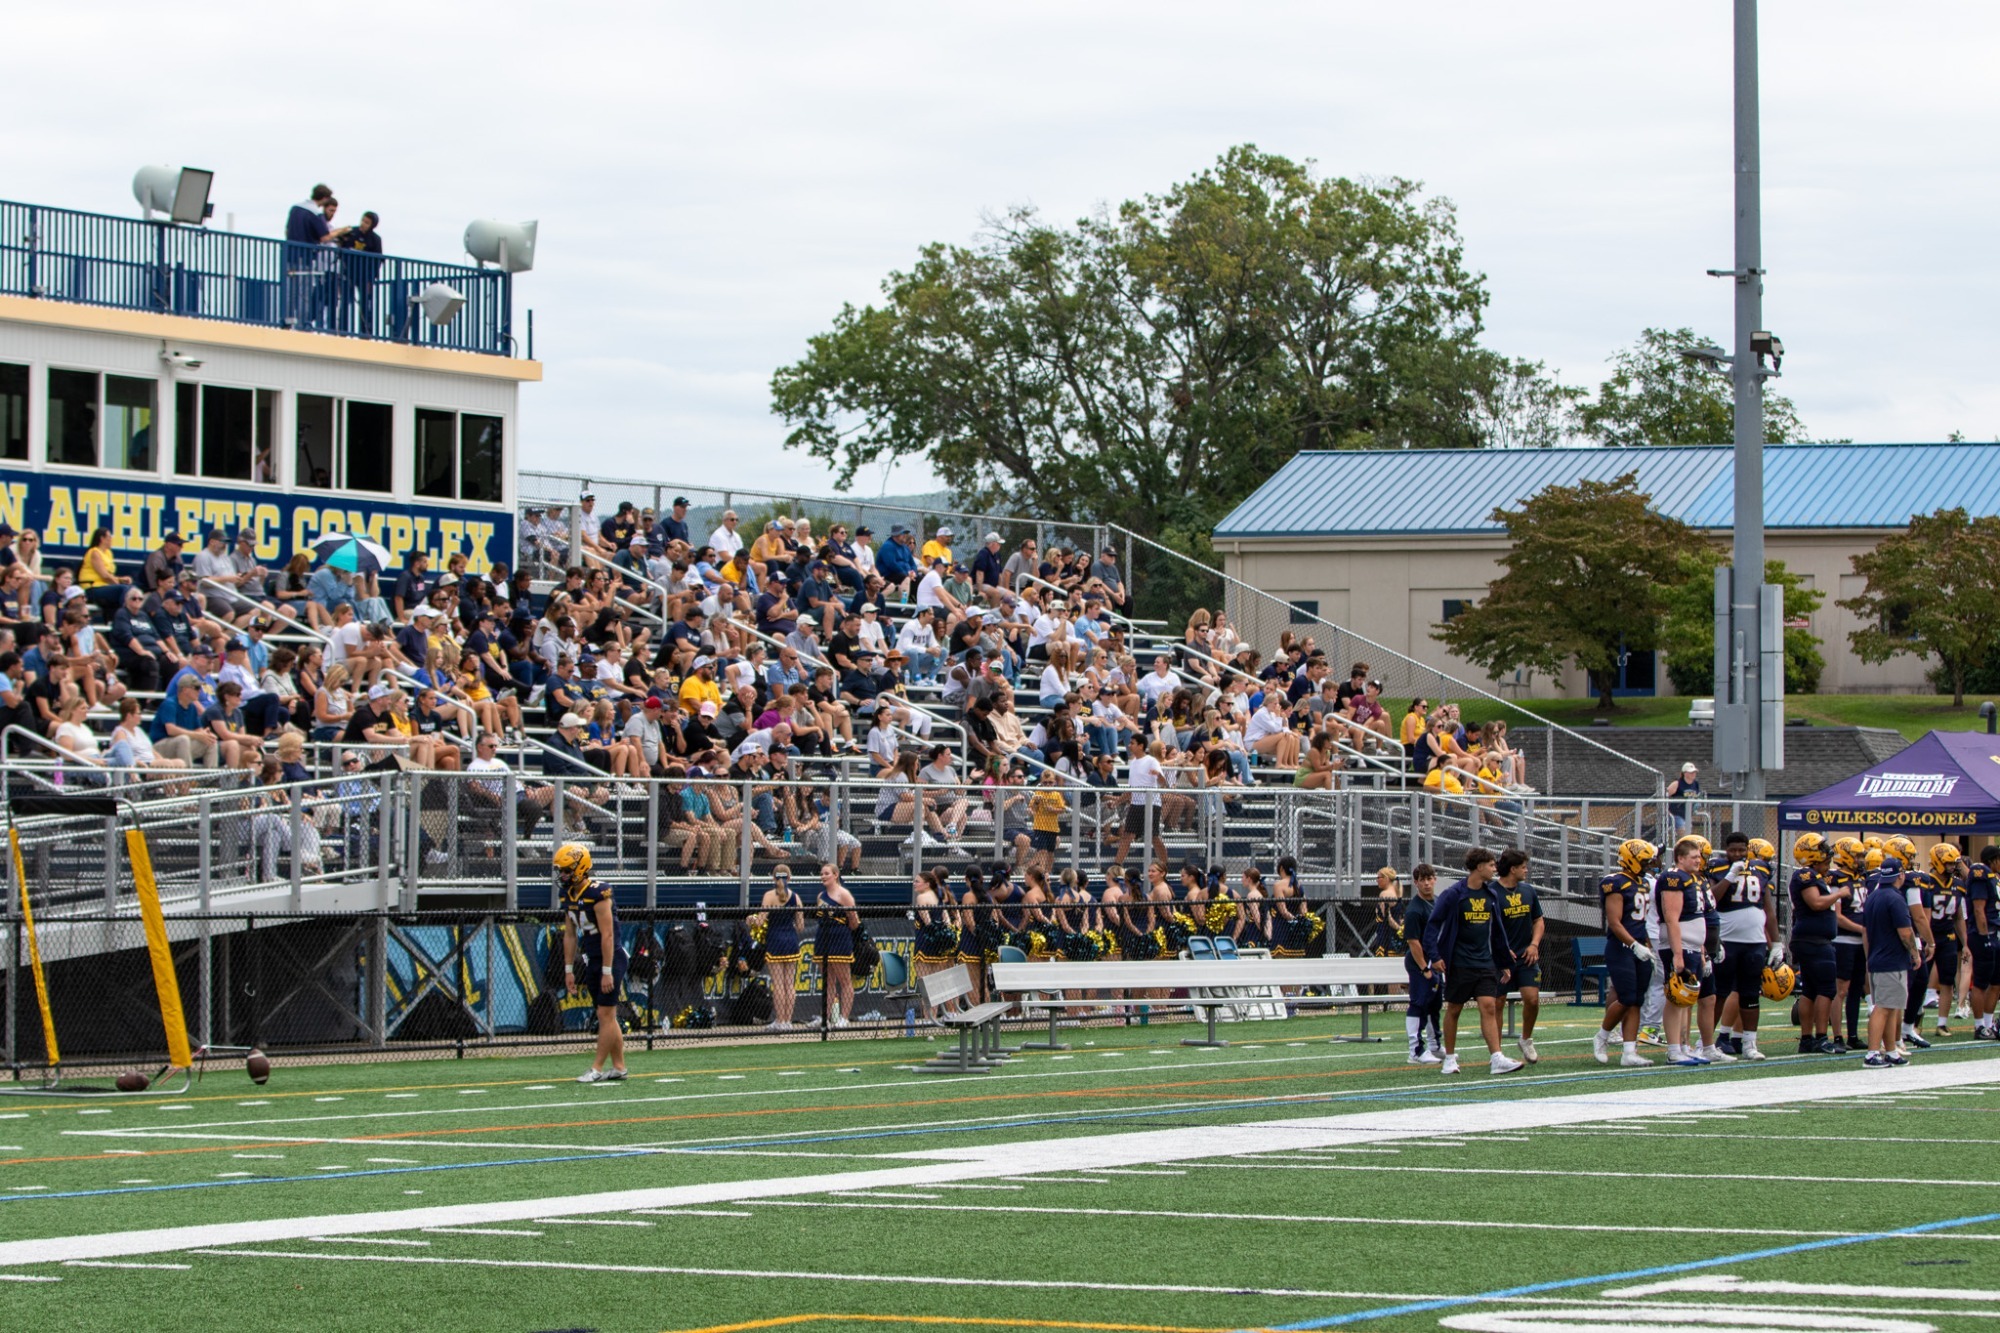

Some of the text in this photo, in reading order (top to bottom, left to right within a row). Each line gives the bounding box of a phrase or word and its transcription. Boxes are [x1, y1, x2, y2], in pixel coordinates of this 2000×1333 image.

[43, 486, 281, 560] ATHLETIC
[1857, 777, 1959, 794] LANDMARK
[1806, 809, 1977, 825] @WILKESCOLONELS
[1731, 875, 1760, 903] 78
[1504, 905, 1530, 916] WILKES
[1932, 895, 1956, 919] 54
[1464, 912, 1491, 920] WILKES
